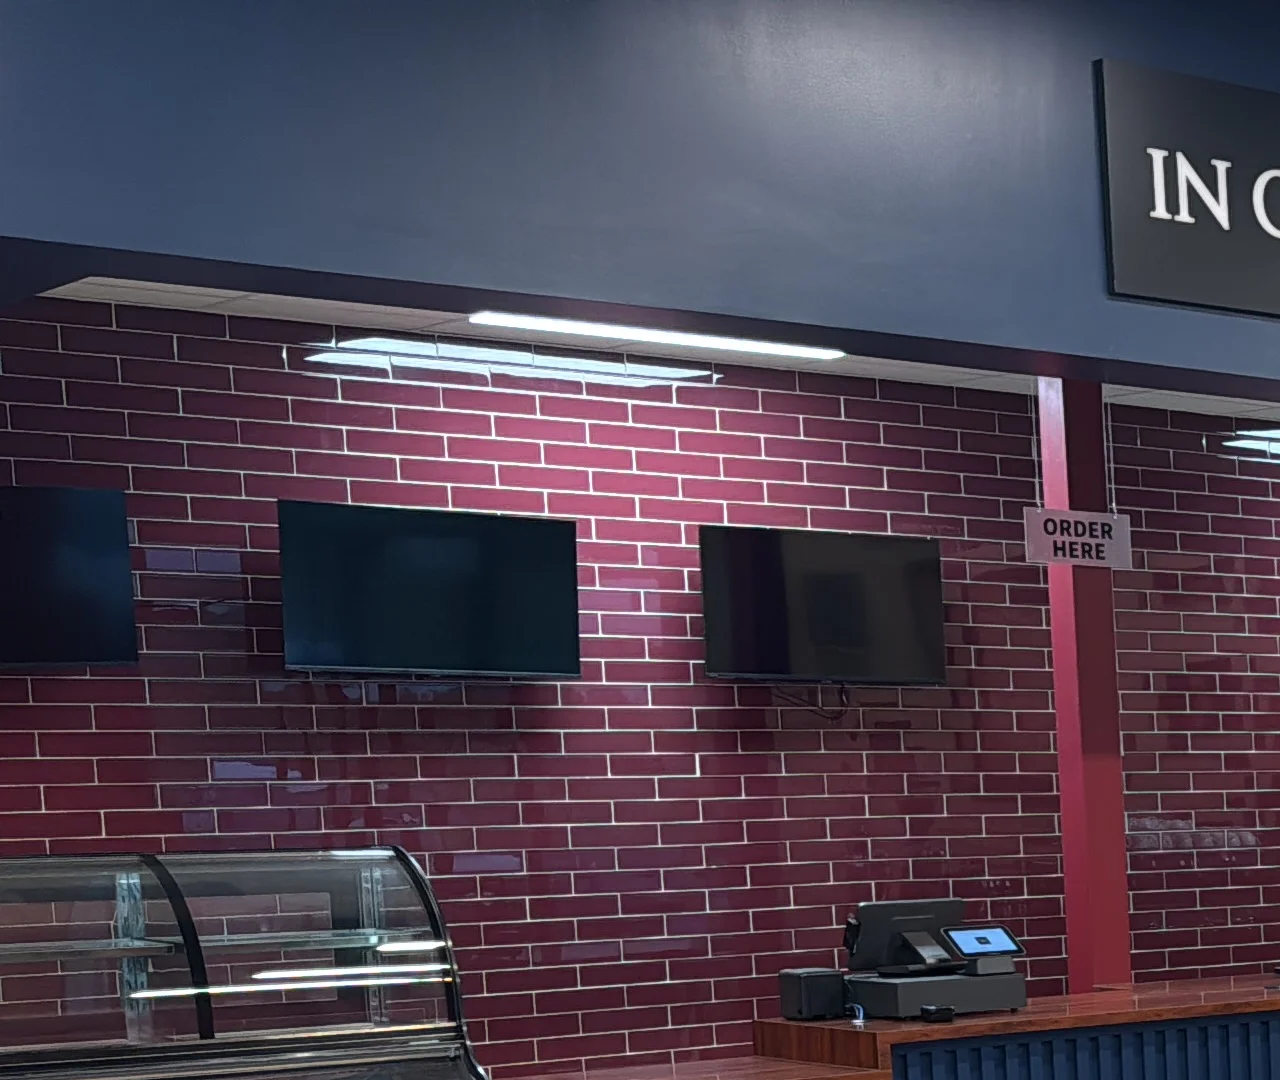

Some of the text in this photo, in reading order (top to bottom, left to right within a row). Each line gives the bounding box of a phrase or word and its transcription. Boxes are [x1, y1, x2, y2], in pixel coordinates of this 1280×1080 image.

[1146, 147, 1232, 231] IN
[1043, 517, 1113, 540] ORDER
[1053, 540, 1106, 560] HERE
